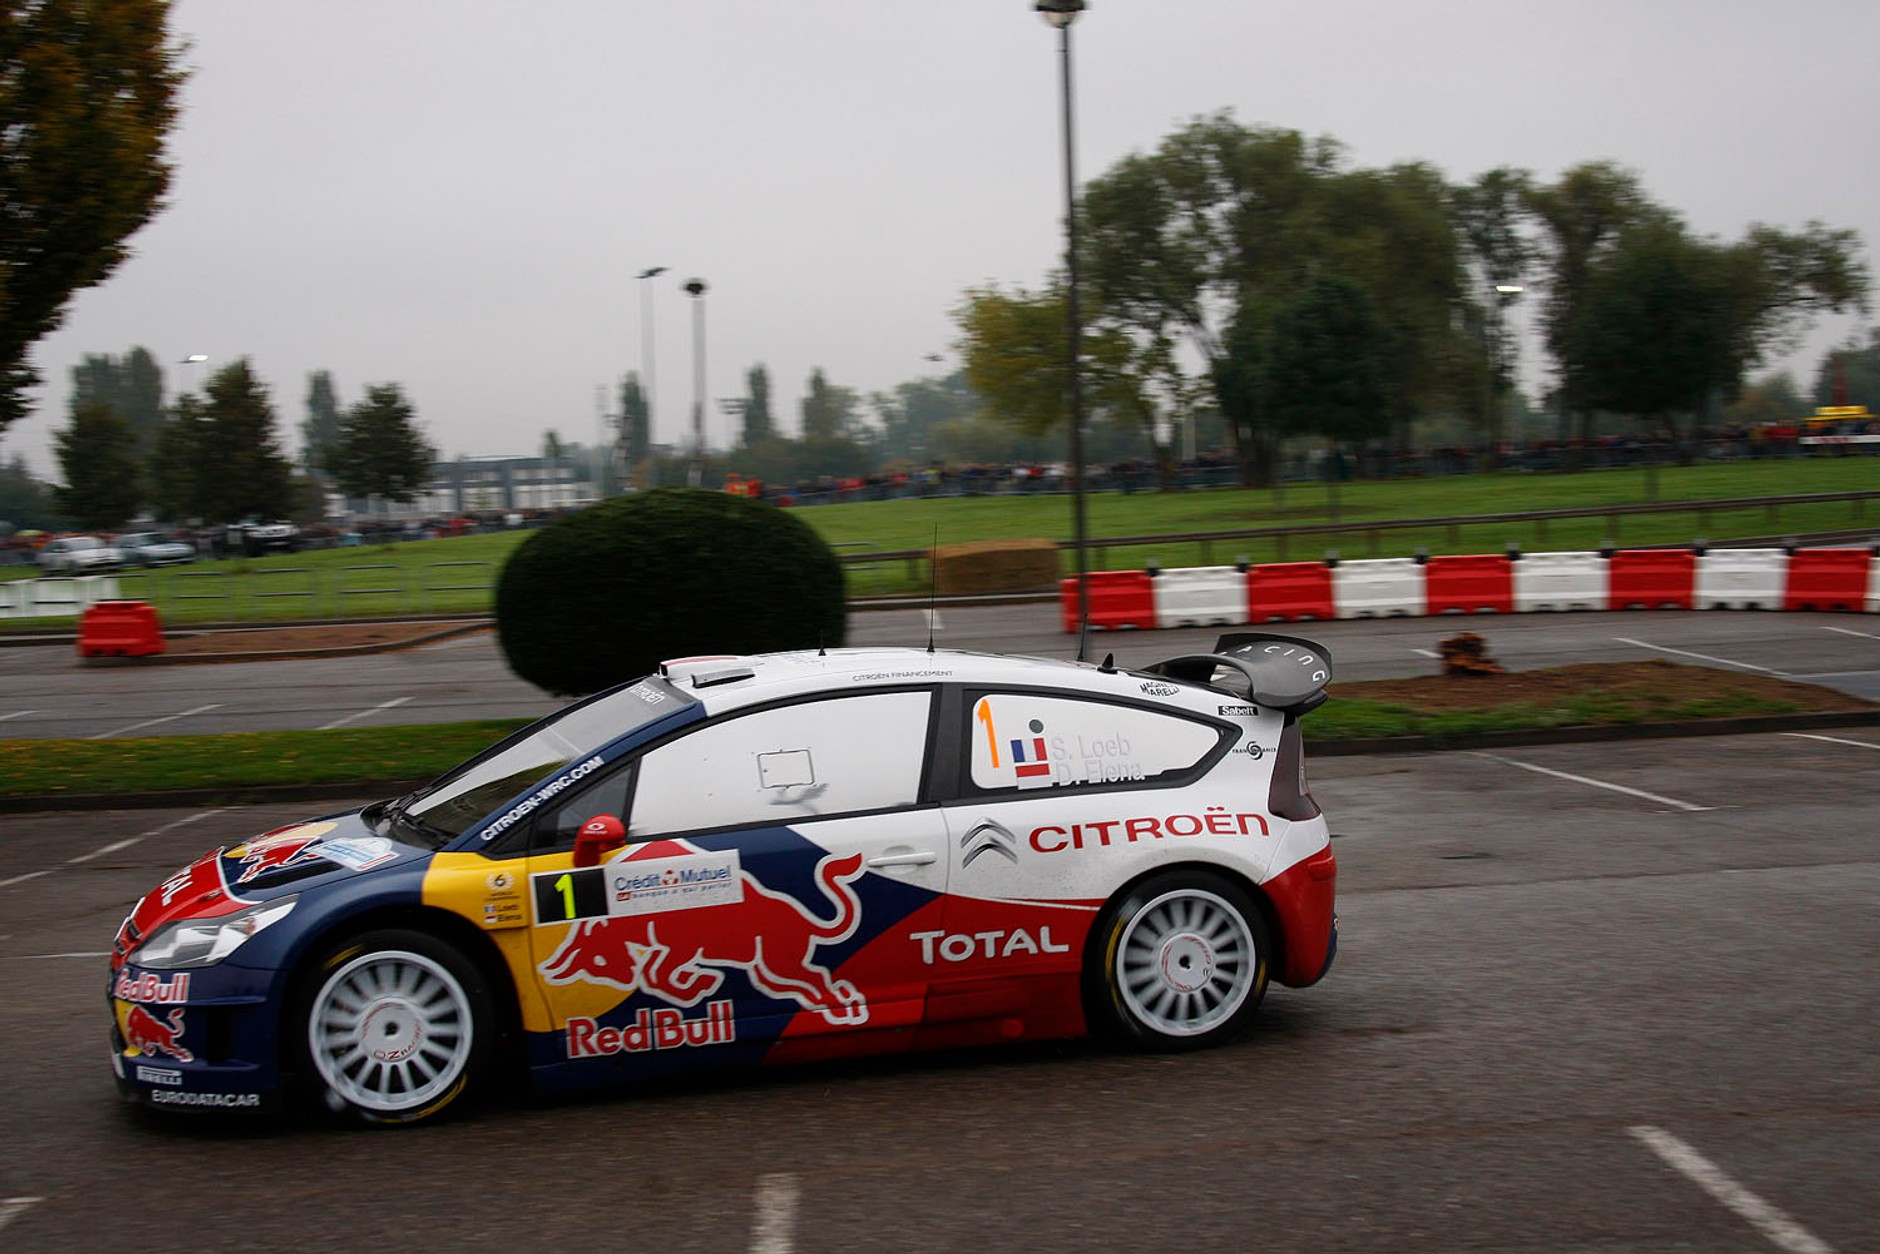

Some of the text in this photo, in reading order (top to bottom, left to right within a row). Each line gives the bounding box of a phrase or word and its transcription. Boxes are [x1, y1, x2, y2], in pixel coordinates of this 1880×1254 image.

[1218, 646, 1326, 682] ACING
[1221, 706, 1254, 716] Sabelt
[977, 699, 999, 768] 1
[1078, 732, 1131, 759] Loeb
[1085, 760, 1147, 784] Elena
[494, 873, 505, 887] 6
[614, 865, 731, 891] Crédit Mutuel
[554, 873, 576, 919] 1
[909, 925, 1070, 965] TOTAL
[152, 1089, 260, 1107] EURODATACAR
